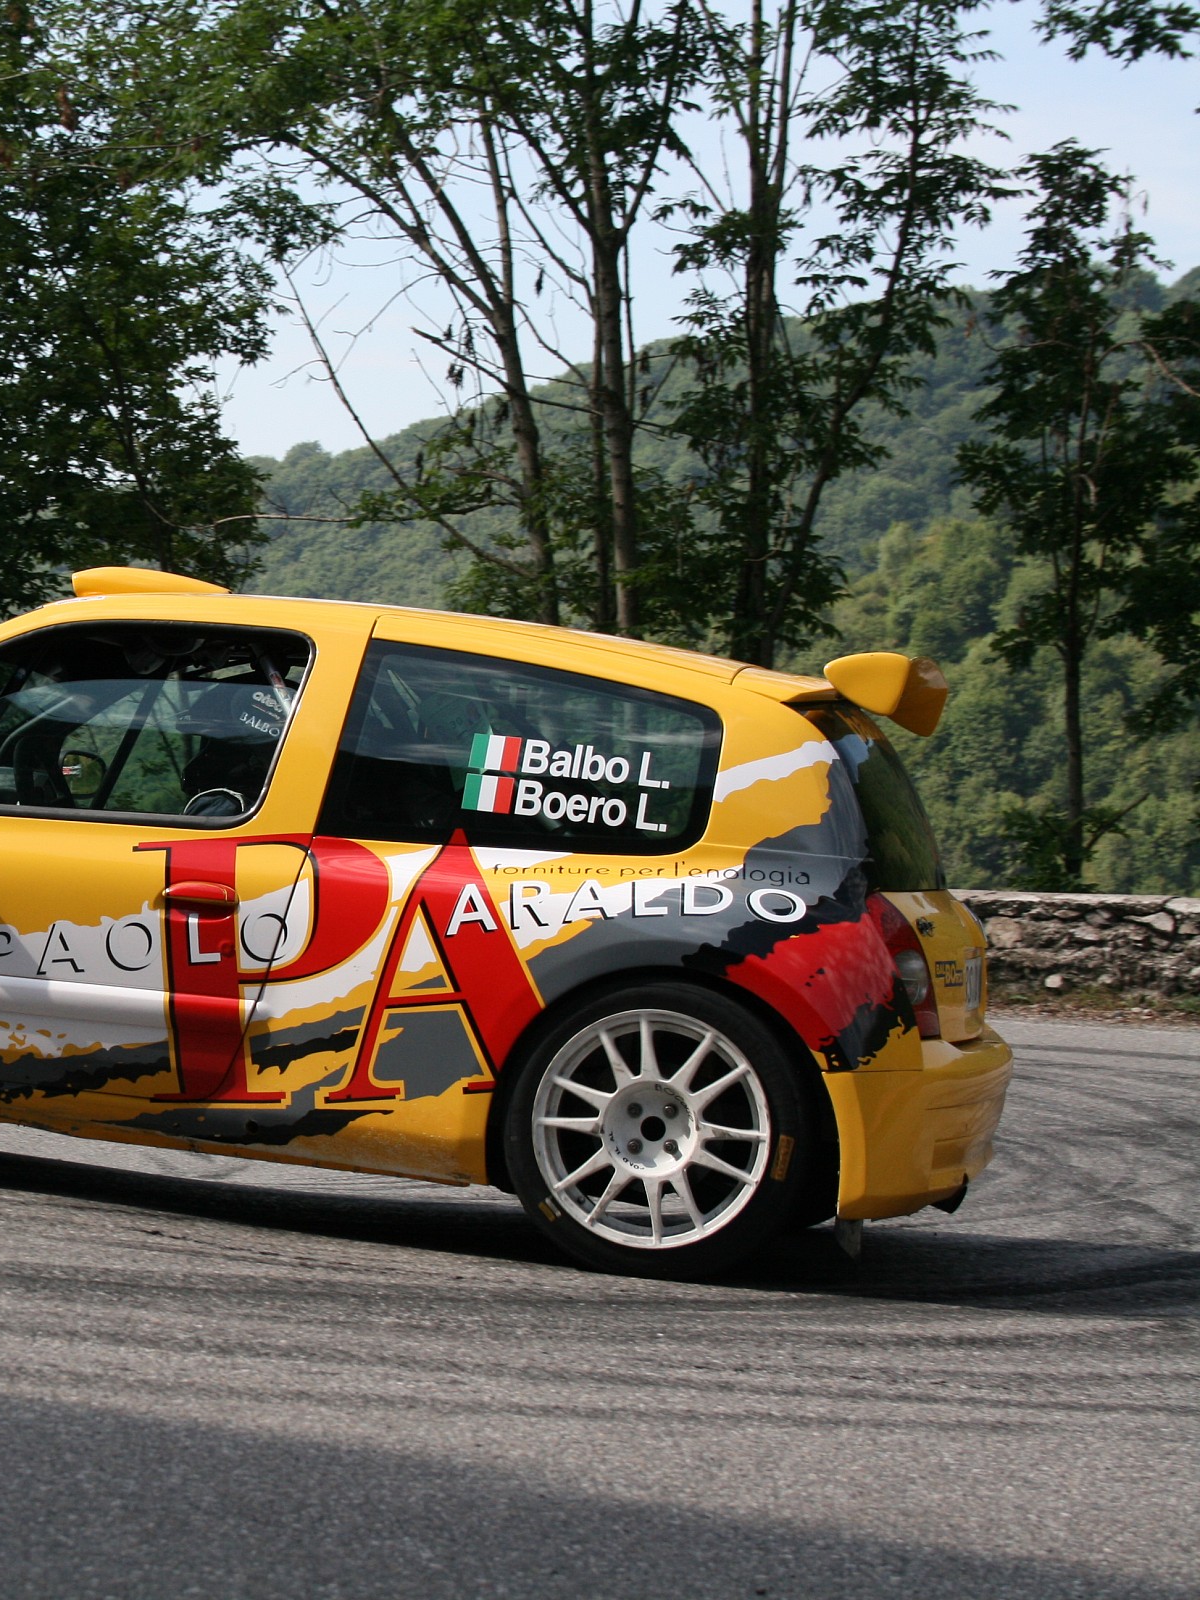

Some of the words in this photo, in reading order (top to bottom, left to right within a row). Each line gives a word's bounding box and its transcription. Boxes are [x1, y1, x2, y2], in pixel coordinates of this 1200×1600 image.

[240, 711, 280, 737] BALBO
[521, 739, 630, 784] Balbo
[638, 751, 670, 790] L.
[514, 779, 628, 827] Boero
[636, 793, 668, 833] L.
[492, 863, 611, 877] forniture
[619, 865, 665, 878] per
[675, 860, 810, 887] l'enologia
[445, 878, 807, 936] ARALDO
